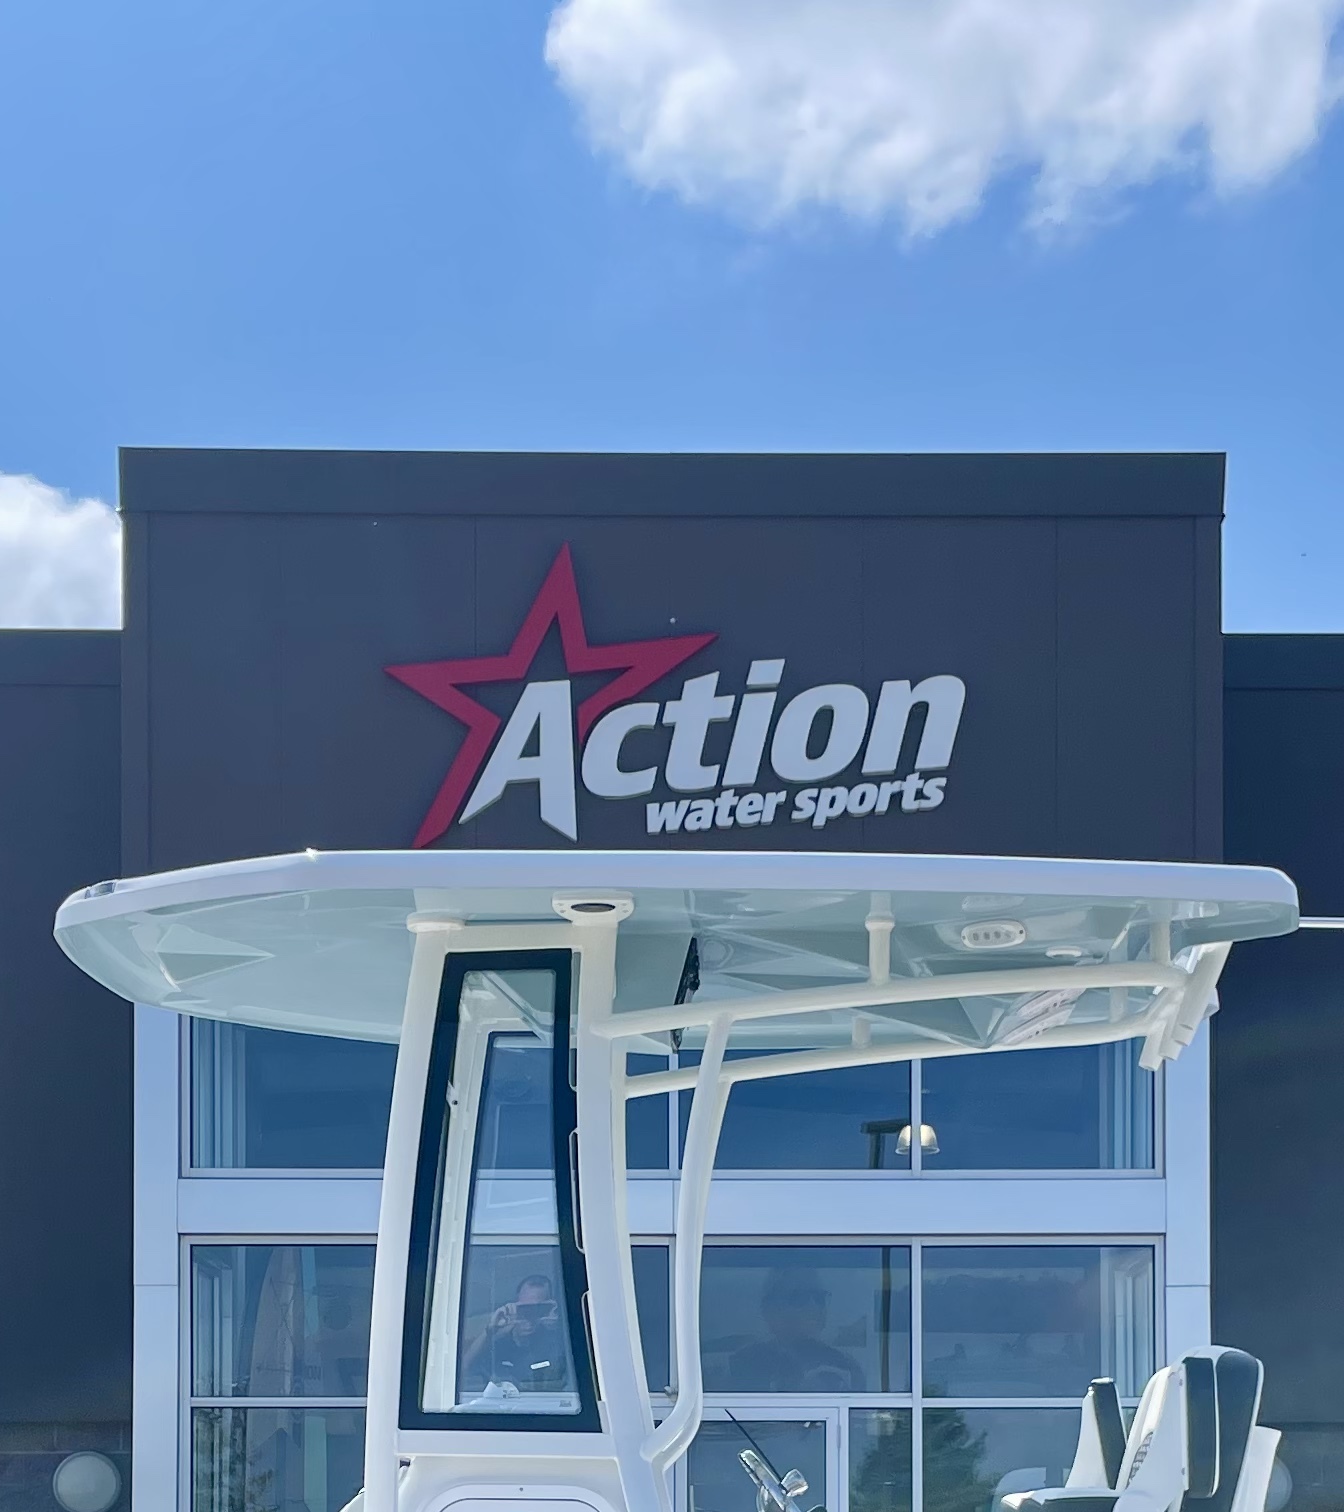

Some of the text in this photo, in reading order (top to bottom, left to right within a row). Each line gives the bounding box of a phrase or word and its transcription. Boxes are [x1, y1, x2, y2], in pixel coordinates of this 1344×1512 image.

[458, 658, 967, 843] Action
[646, 772, 948, 836] water sports
